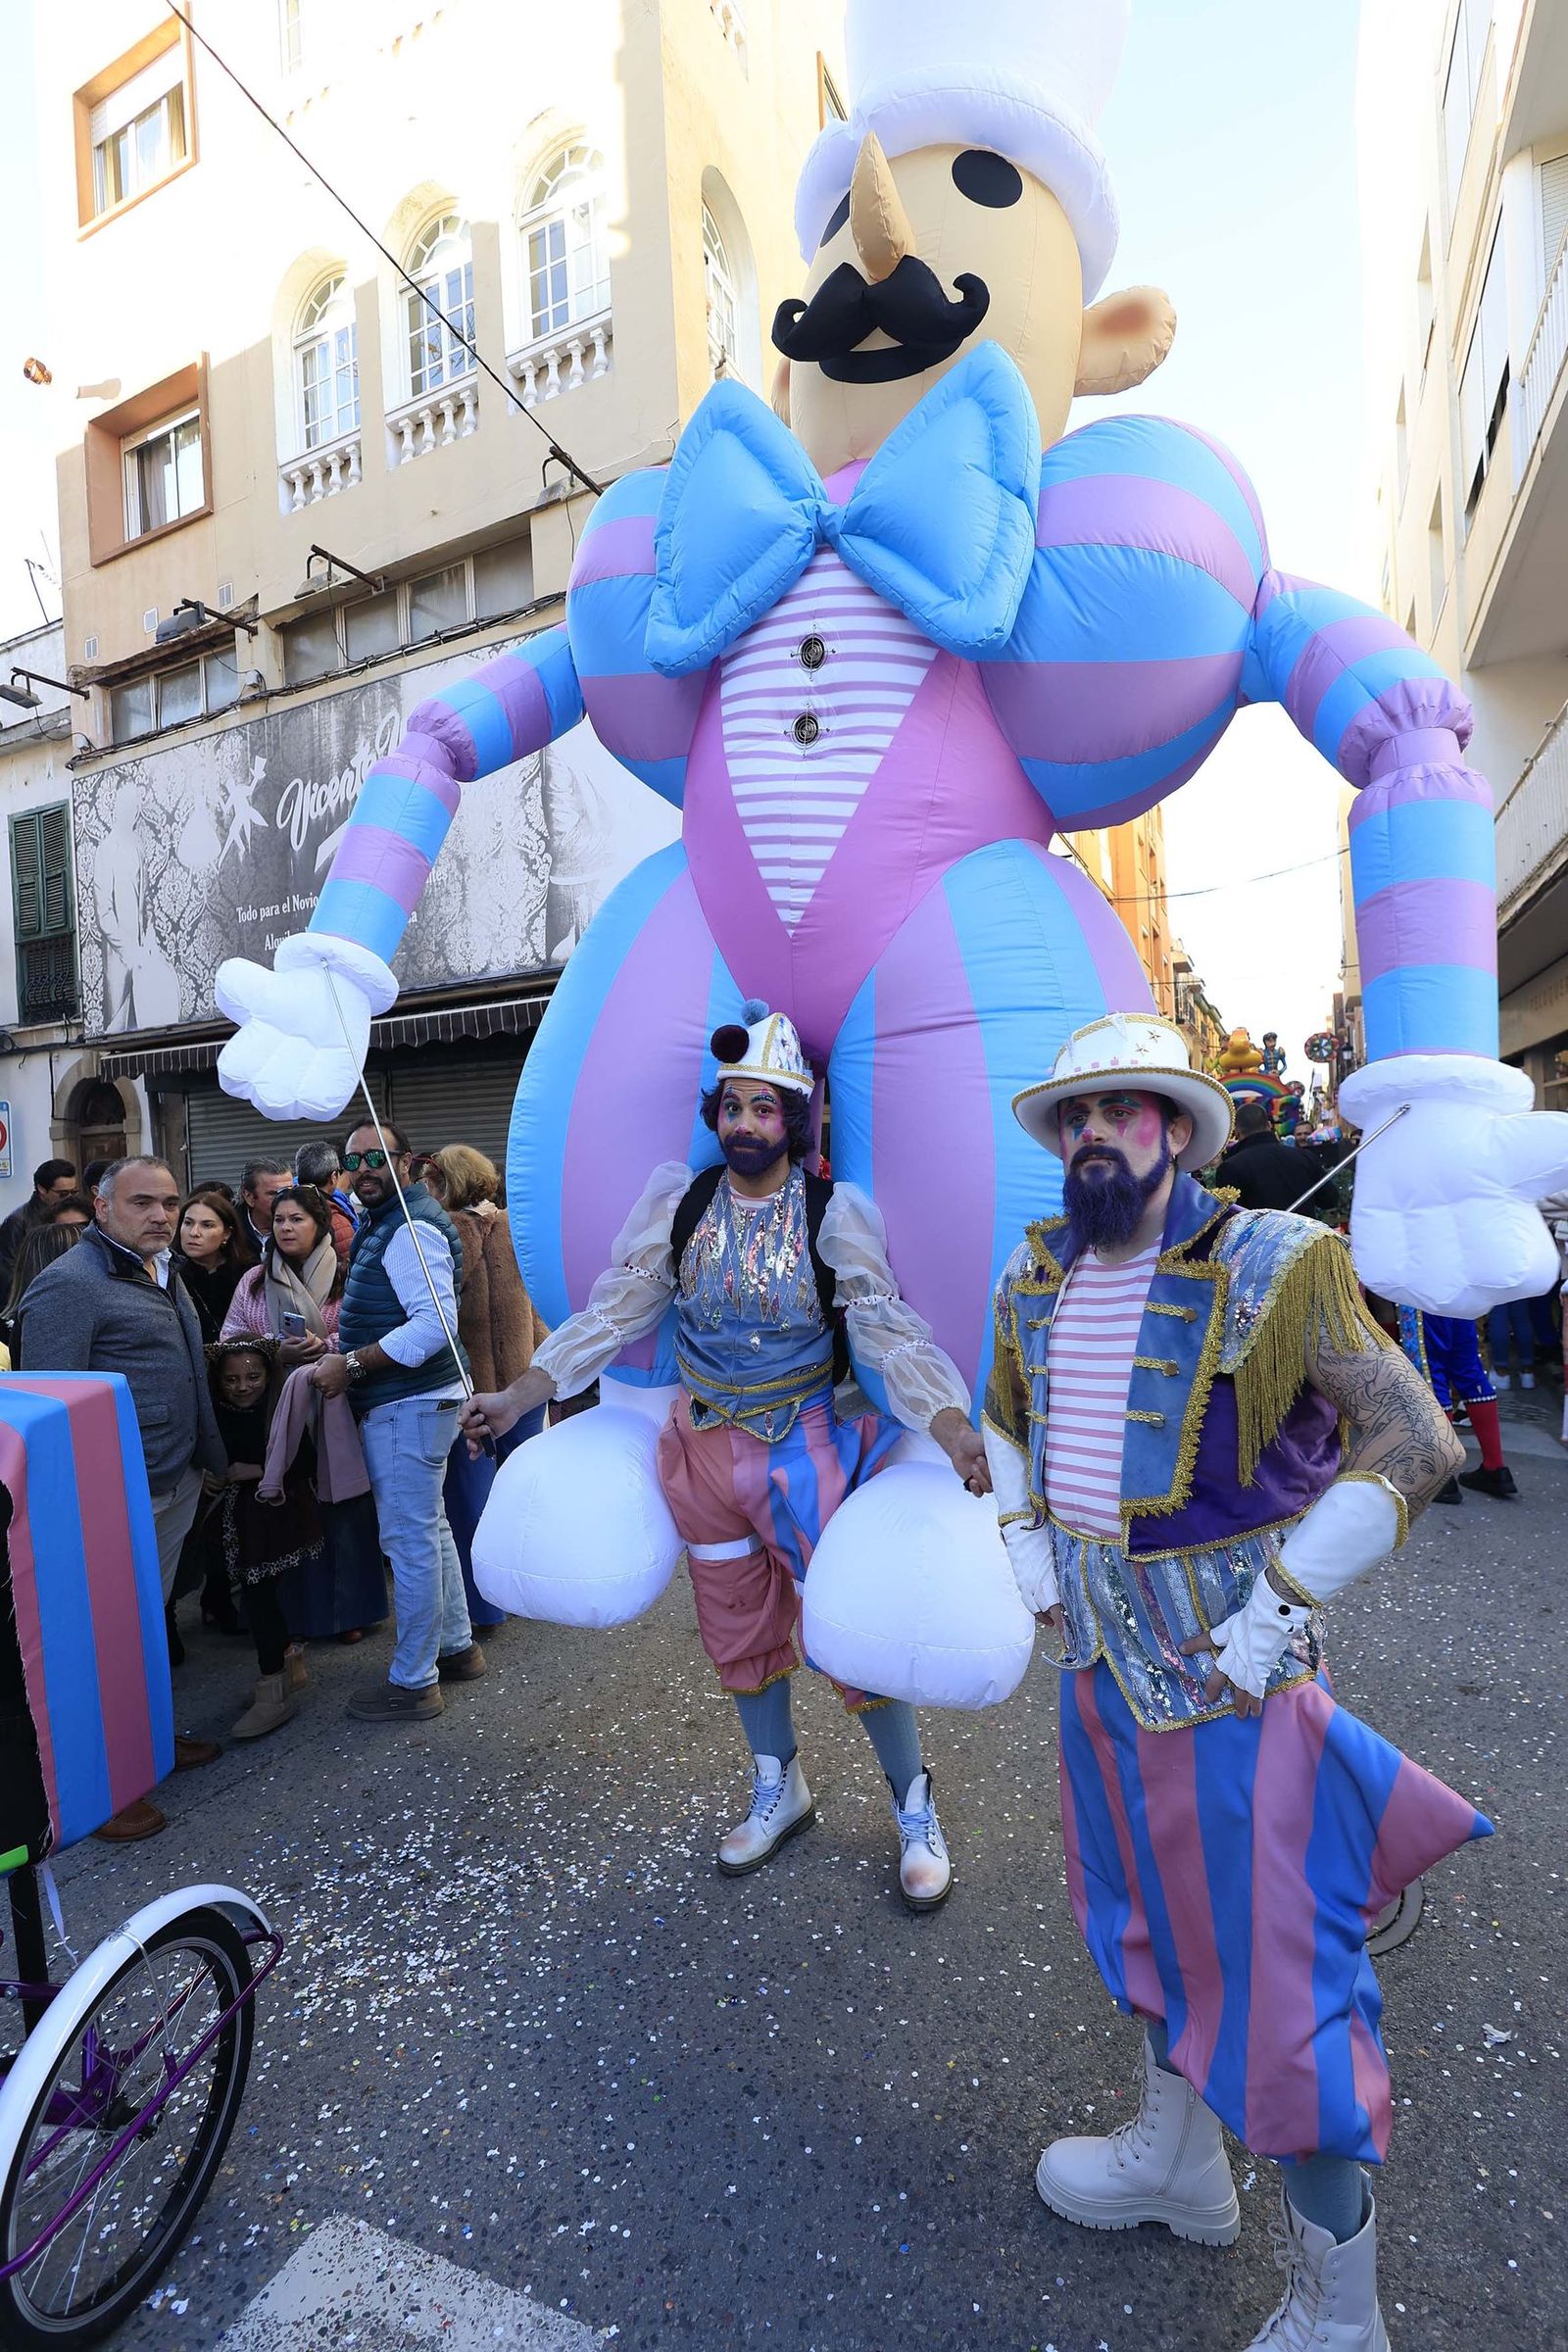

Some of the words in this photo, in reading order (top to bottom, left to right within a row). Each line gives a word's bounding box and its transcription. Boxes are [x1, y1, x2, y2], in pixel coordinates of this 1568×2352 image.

[235, 905, 258, 923] Todo
[260, 904, 280, 921] para
[281, 896, 291, 913] el
